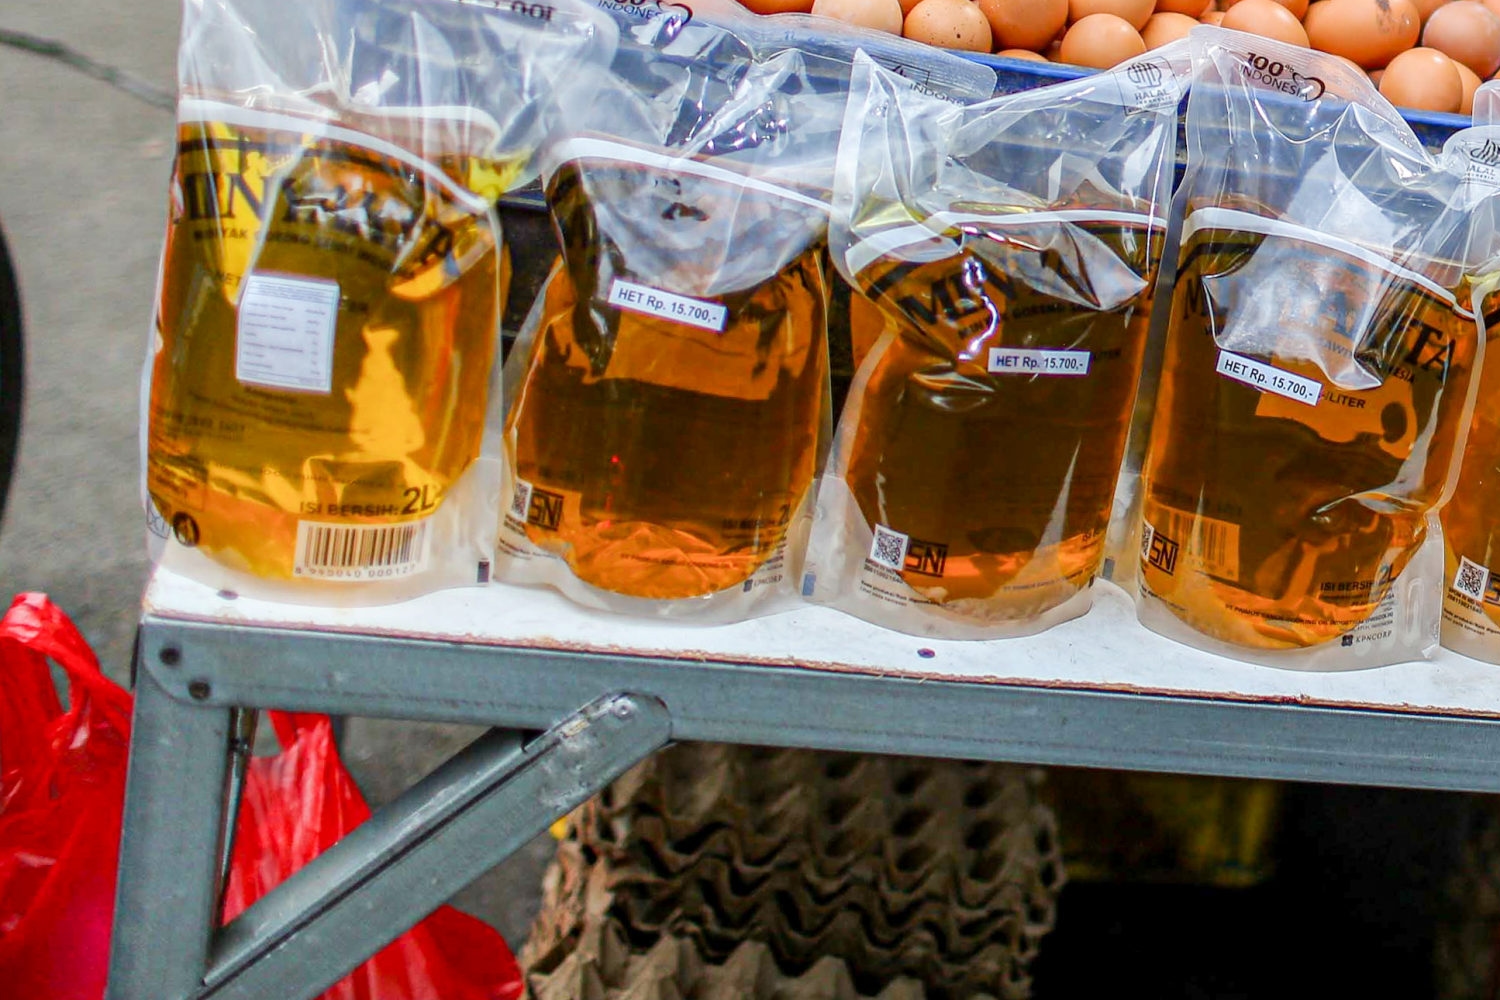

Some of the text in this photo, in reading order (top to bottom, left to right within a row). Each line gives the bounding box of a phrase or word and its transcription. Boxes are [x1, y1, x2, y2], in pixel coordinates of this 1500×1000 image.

[618, 287, 718, 323] HET Rp. 15.700,-
[996, 356, 1084, 370] HET Rp. 15.700,-
[1224, 358, 1314, 399] HET Rp. 15.700,-
[401, 484, 435, 515] 2L
[1150, 531, 1180, 576] SNI
